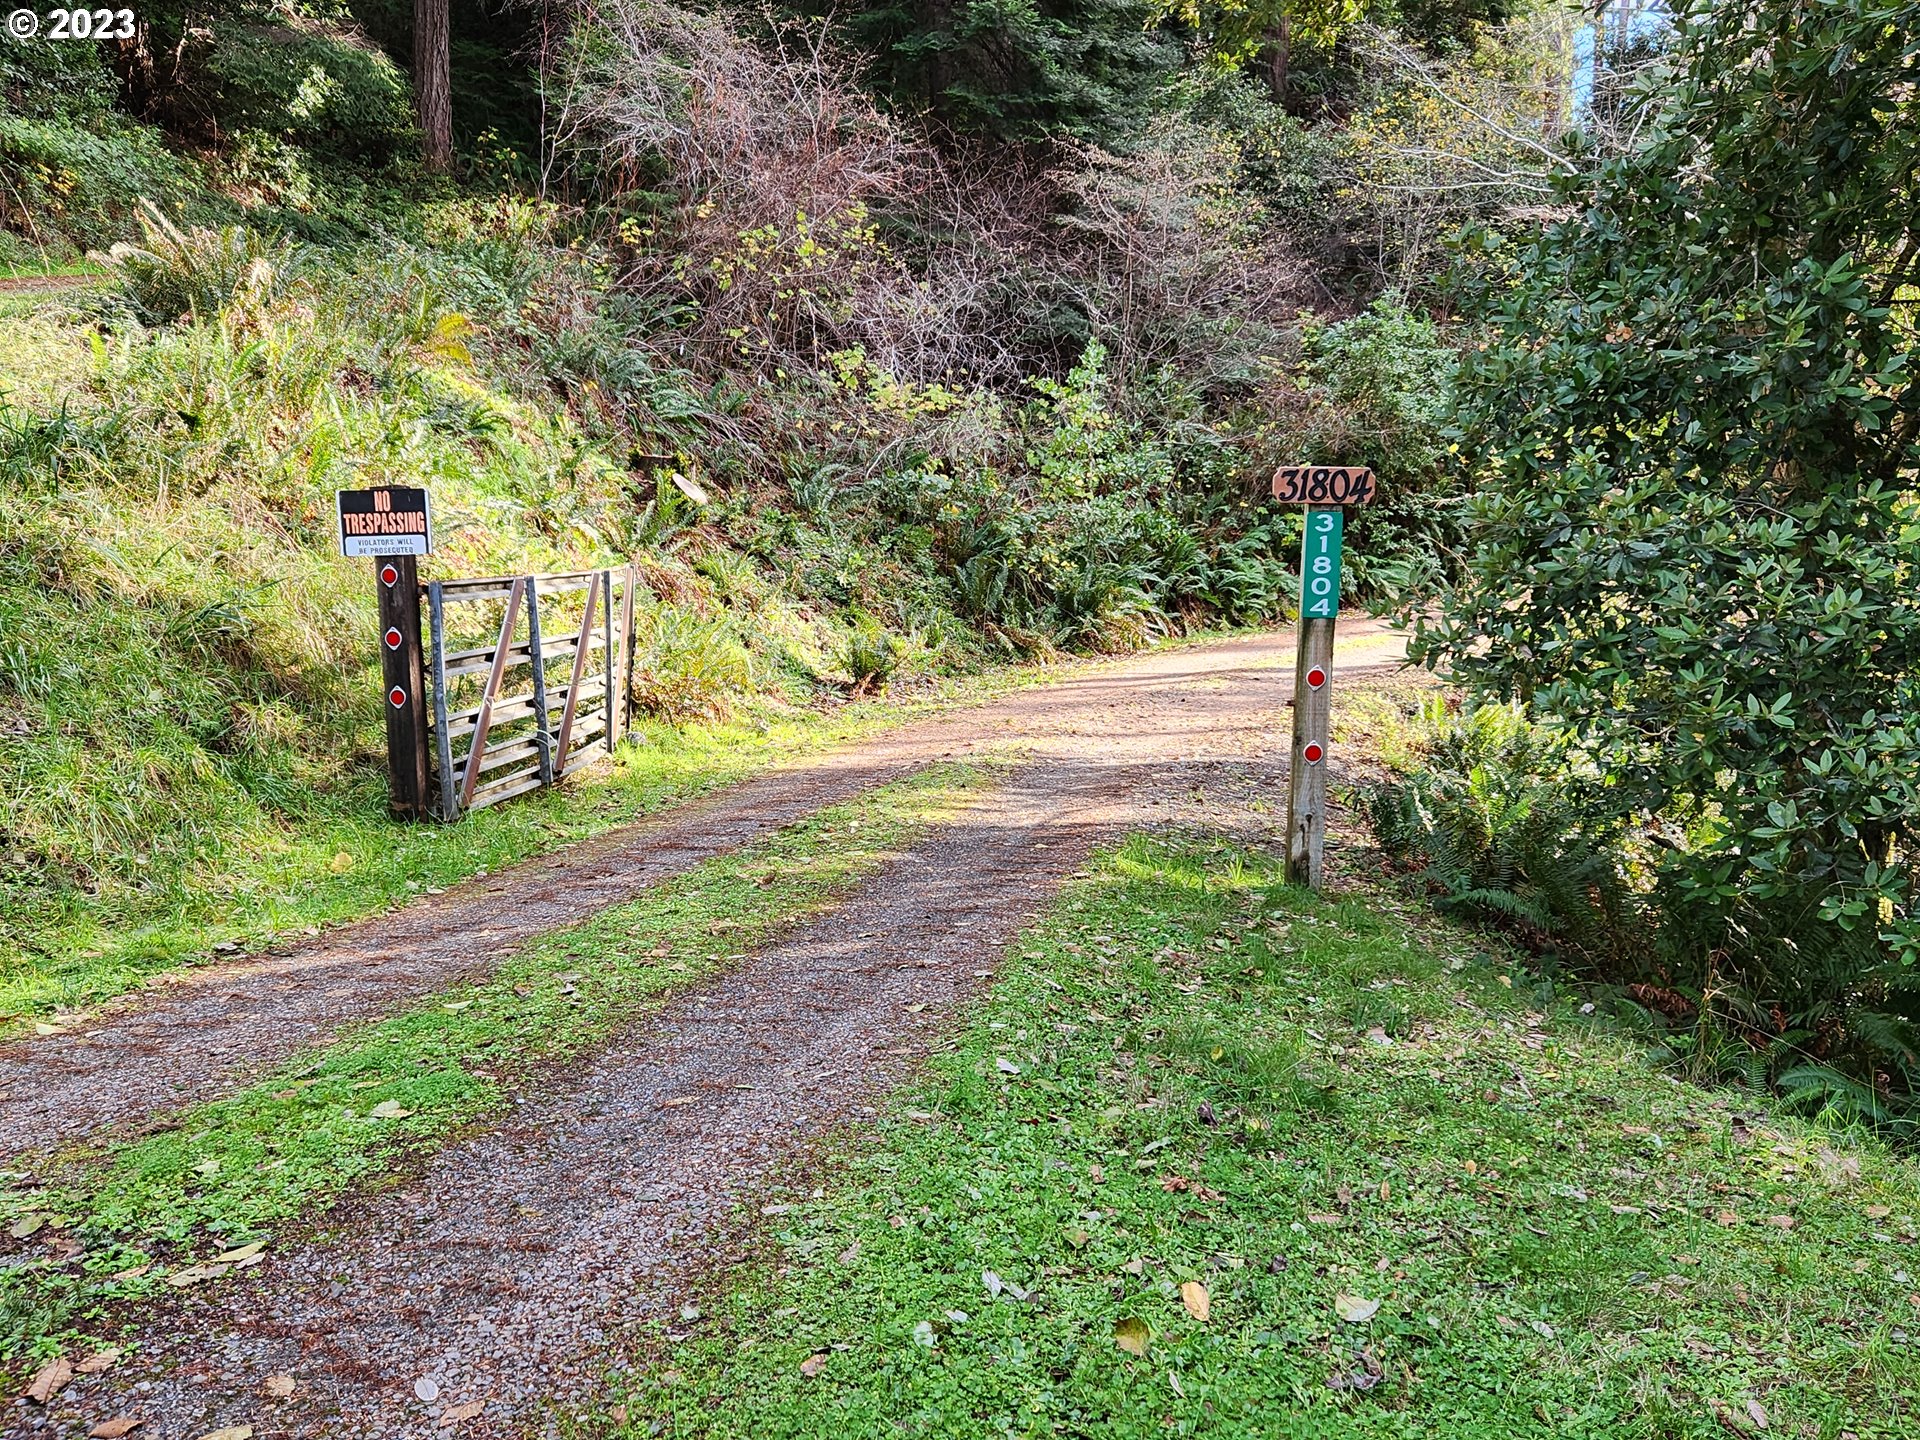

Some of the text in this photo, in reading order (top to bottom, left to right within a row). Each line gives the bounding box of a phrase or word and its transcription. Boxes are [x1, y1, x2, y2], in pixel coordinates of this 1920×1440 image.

[1278, 468, 1373, 503] 31804
[373, 490, 391, 512] NO
[343, 511, 426, 535] TRESPASSING
[357, 538, 414, 546] VIOLATORS WILL
[358, 546, 414, 555] BE PROSECUTED
[1309, 513, 1335, 616] 31804
